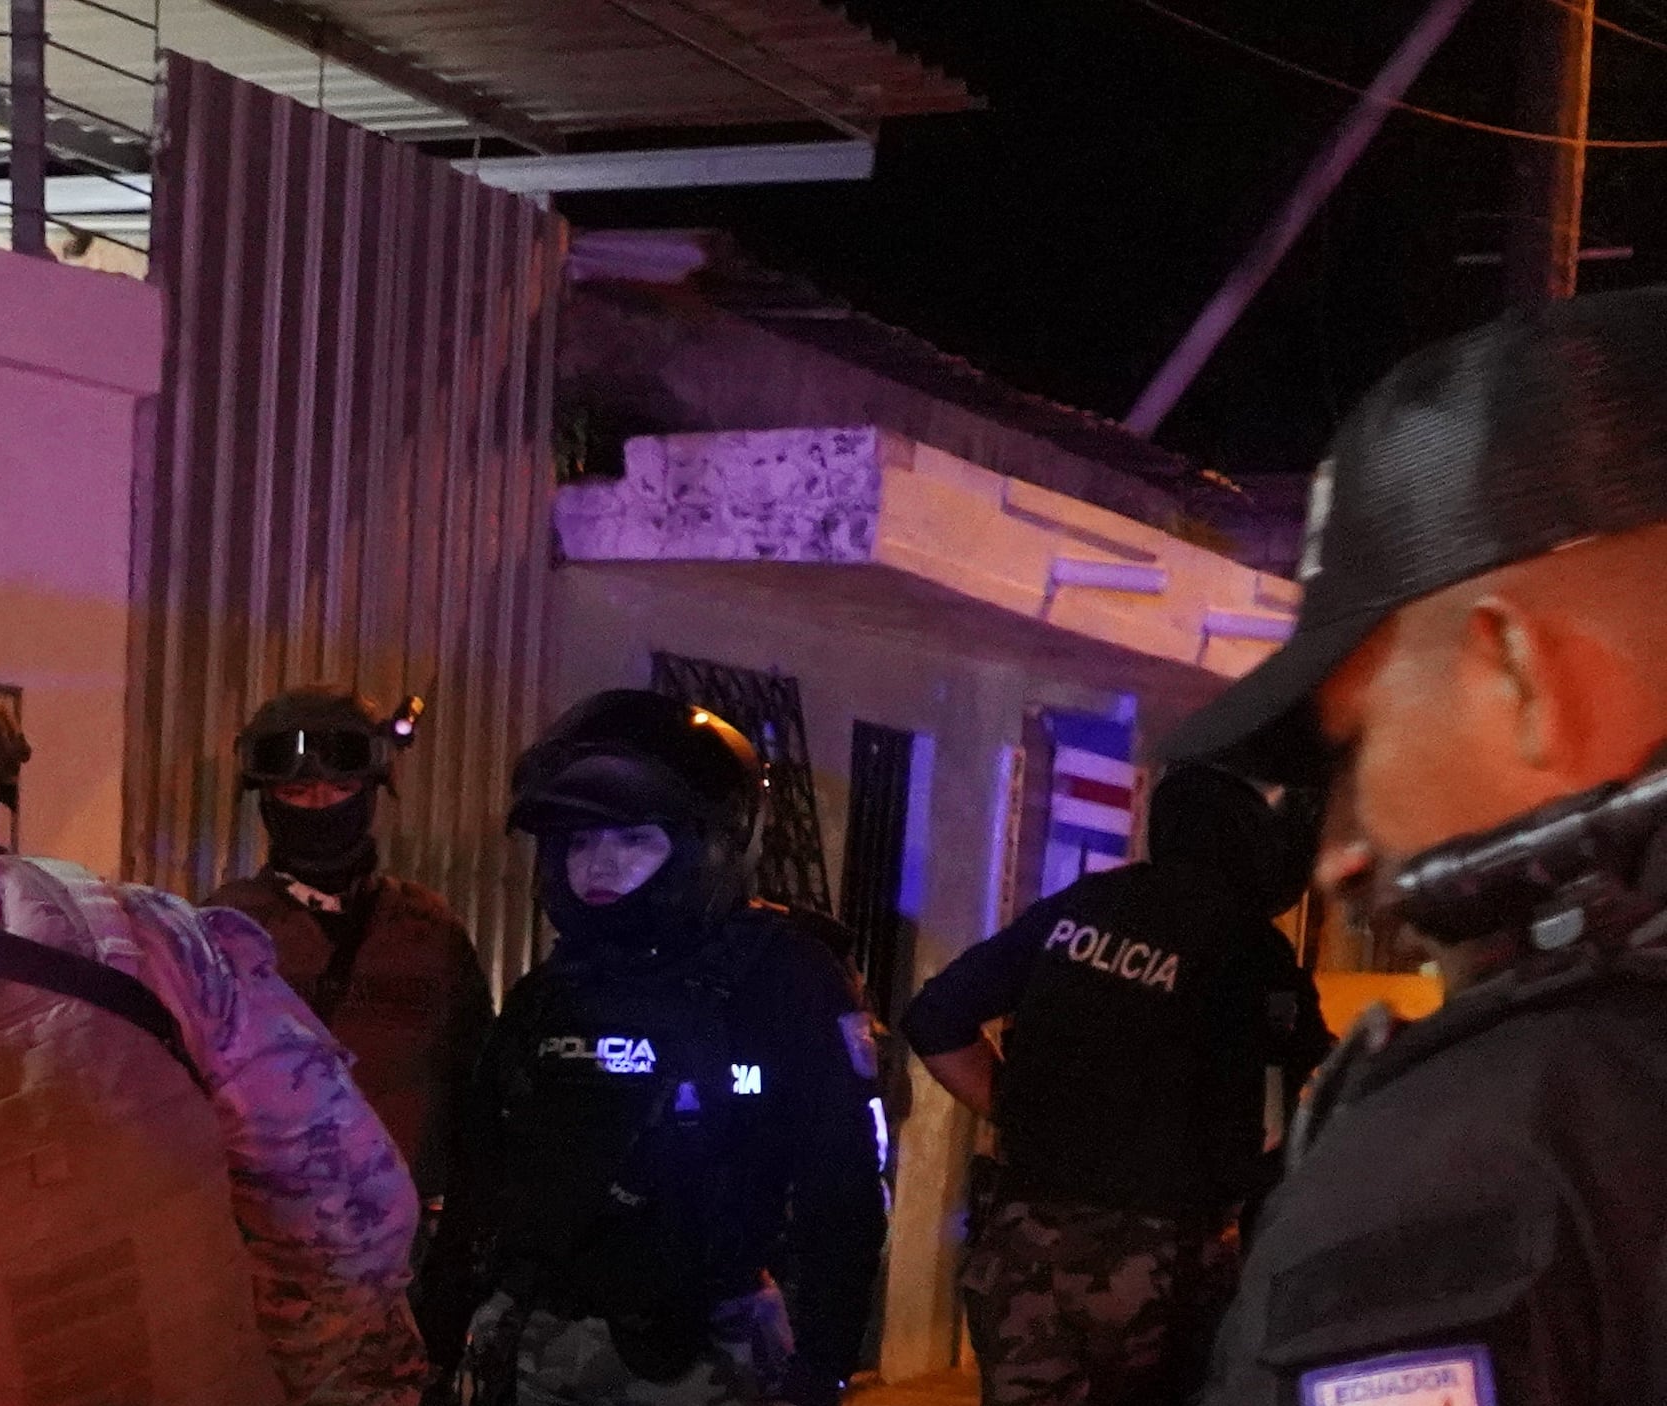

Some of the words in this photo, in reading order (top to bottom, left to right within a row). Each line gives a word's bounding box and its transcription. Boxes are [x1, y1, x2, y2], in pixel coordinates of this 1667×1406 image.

[1044, 918, 1181, 992] POLICIA
[538, 1036, 657, 1063] POLICIA
[1334, 1367, 1460, 1406] ECUADOR
